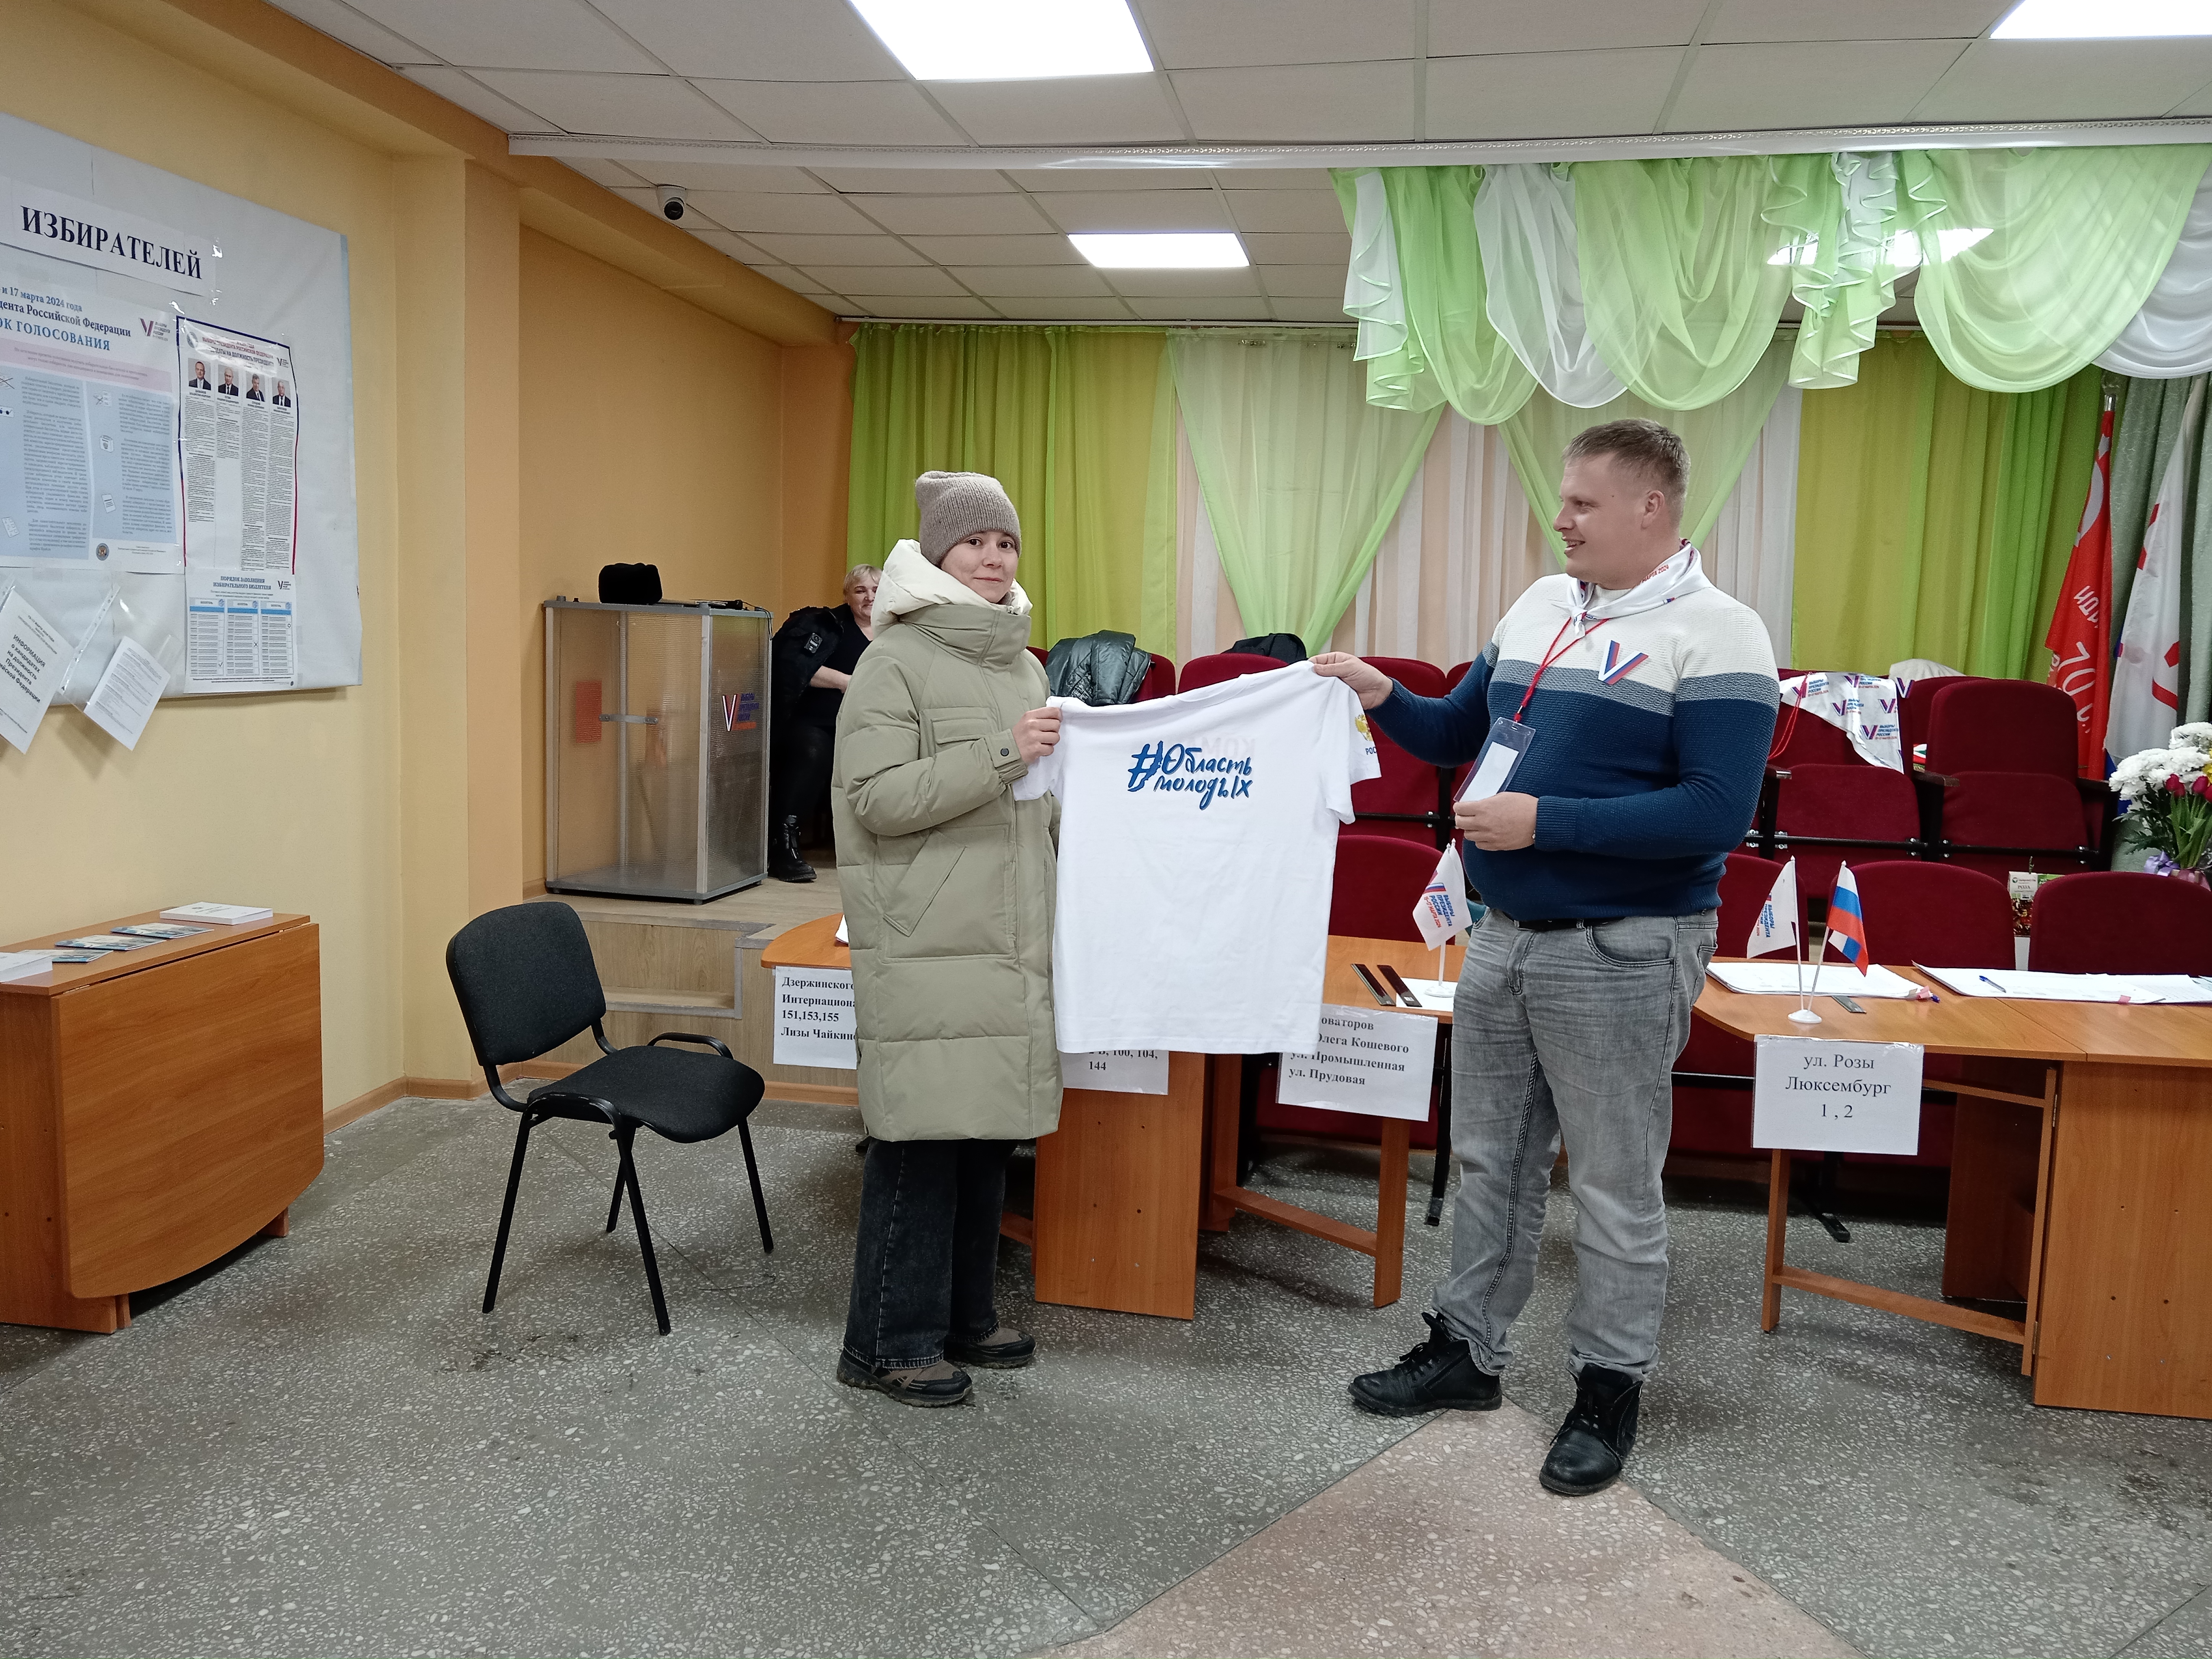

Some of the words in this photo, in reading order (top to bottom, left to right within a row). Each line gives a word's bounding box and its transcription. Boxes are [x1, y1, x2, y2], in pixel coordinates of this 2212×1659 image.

[20, 205, 202, 280] ИЗБИРАТЕЛЕЙ
[10, 287, 18, 296] 17
[21, 292, 44, 303] марта
[46, 296, 65, 307] 2024
[66, 302, 82, 312] года
[27, 304, 81, 326] Российской
[83, 317, 131, 337] Федерации
[16, 320, 110, 351] ГОЛОСОВАНИЯ
[1658, 564, 1669, 574] 2024
[13, 634, 45, 667] ИНФОРМАЦИЯ
[15, 647, 40, 673] кандидатах
[5, 658, 32, 685] Президента
[13, 656, 37, 680] должность
[15, 678, 40, 703] Федерации
[1153, 775, 1253, 810] молодых
[1428, 905, 1437, 919] МАРТА
[1429, 895, 1443, 915] РОССИИ
[1436, 895, 1452, 927] ПРЕЗИДЕНТА
[1443, 895, 1455, 917] ВЫБОРЫ
[782, 1010, 839, 1022] 151,153,155
[781, 1027, 809, 1038] Лизы
[1138, 1050, 1158, 1060] 104,
[1351, 1036, 1409, 1054] Кошевого
[1089, 1061, 1106, 1070] 144
[1803, 1056, 1827, 1070] ул.
[1834, 1054, 1874, 1069] Розы
[1289, 1068, 1305, 1078] ул.
[1310, 1069, 1365, 1085] Прудовая
[1785, 1076, 1892, 1097] Люксембург
